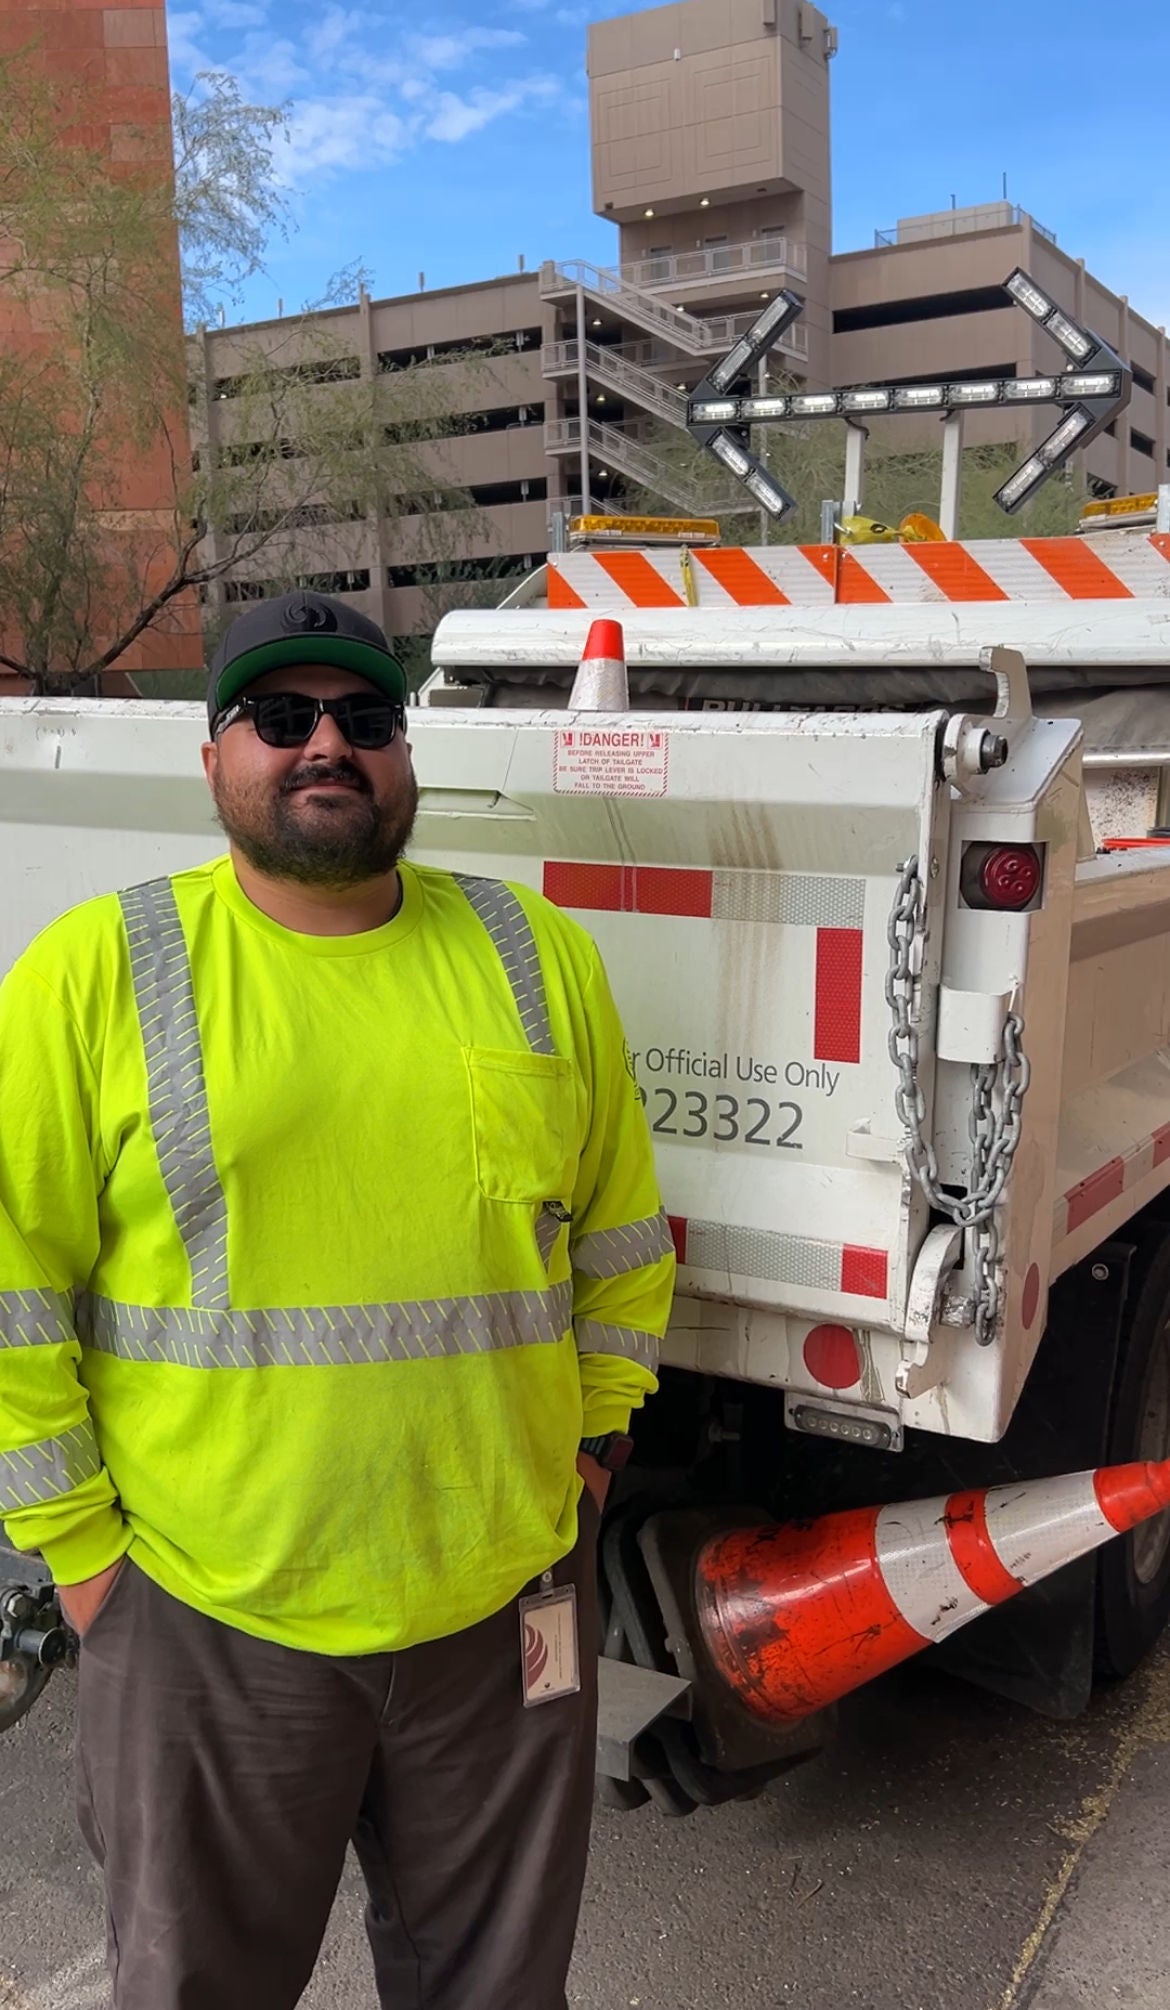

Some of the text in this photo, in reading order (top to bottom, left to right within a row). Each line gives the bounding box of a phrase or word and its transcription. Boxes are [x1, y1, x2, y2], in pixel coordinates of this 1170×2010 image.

[646, 1047, 728, 1079] Official
[736, 1056, 778, 1084] Use
[784, 1060, 840, 1097] Only
[639, 1086, 803, 1150] 23322
